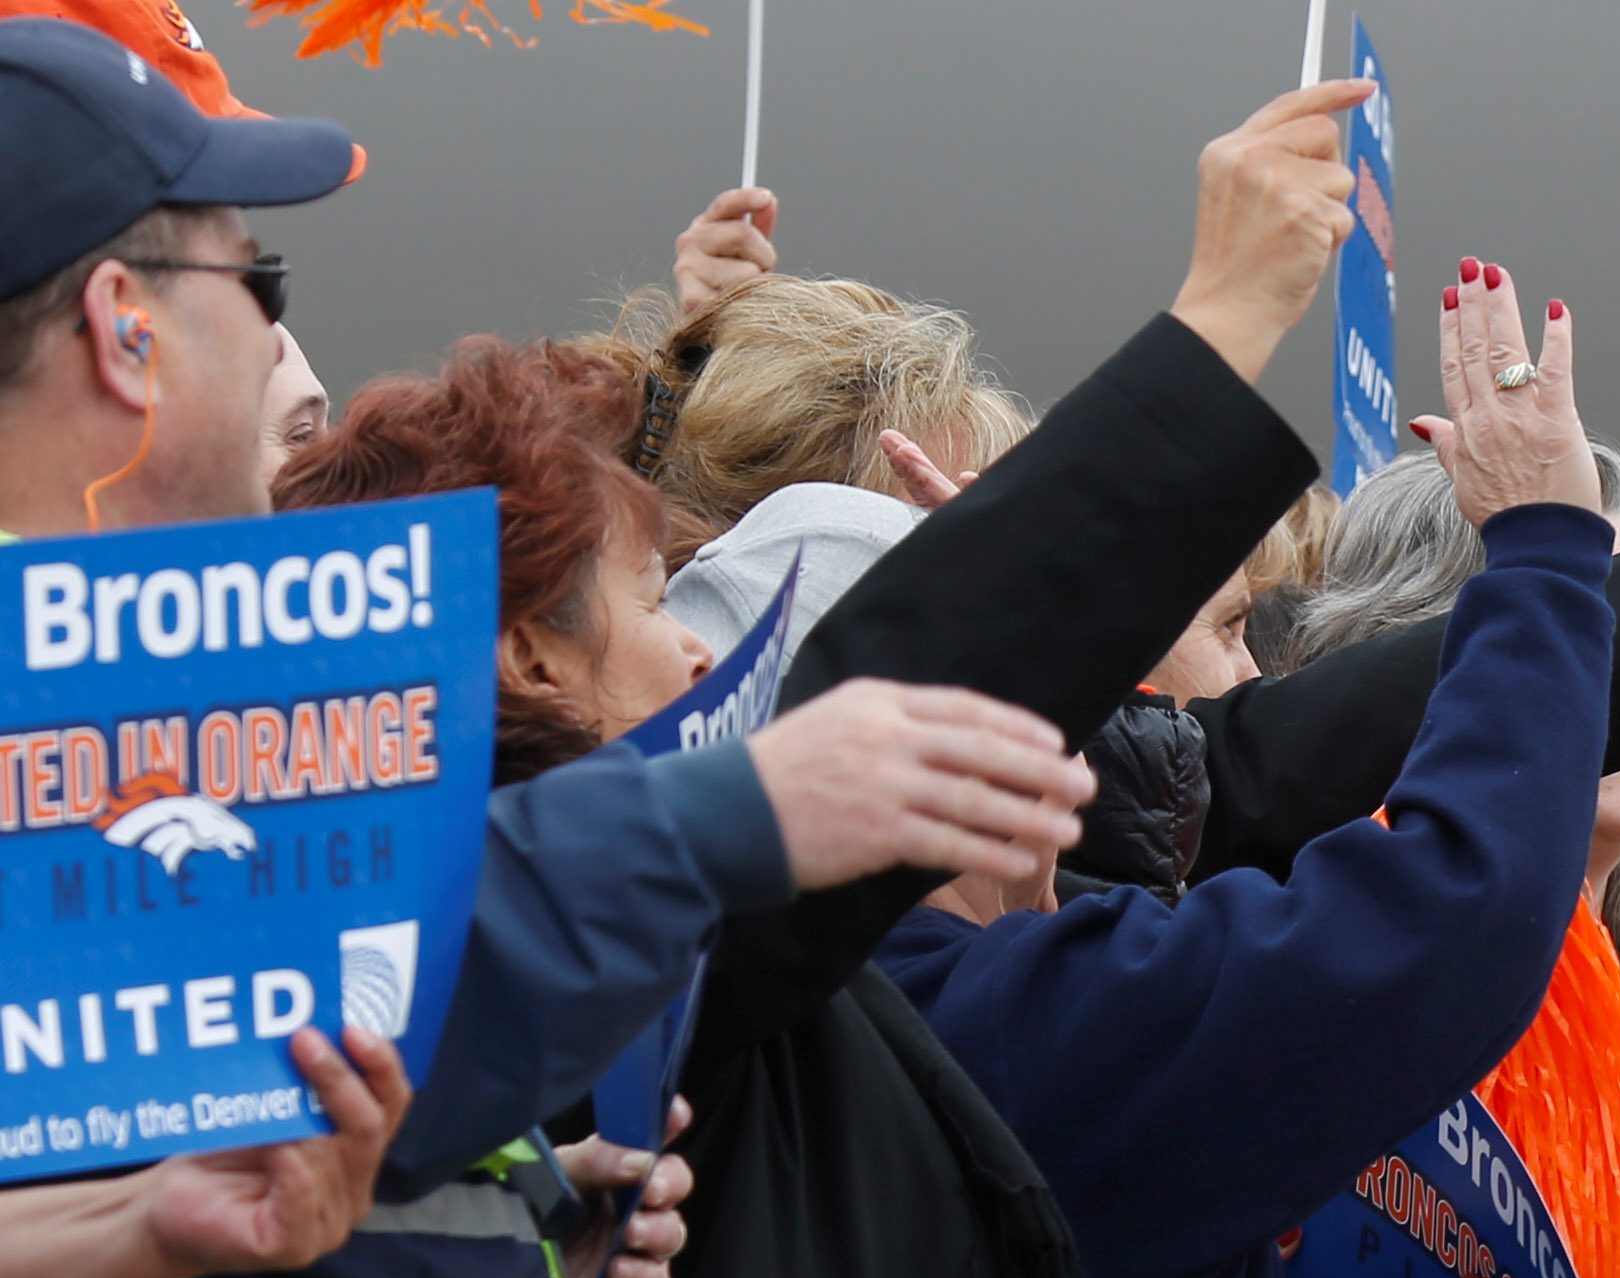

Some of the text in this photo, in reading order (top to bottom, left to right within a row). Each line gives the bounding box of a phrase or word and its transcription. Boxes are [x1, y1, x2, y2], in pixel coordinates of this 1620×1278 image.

[24, 523, 432, 671] Broncos!
[117, 716, 189, 795] IN
[198, 686, 439, 806] ORANGE
[53, 824, 393, 921] MILE HIGH
[2, 969, 315, 1074] NITED
[47, 1114, 84, 1151] to
[86, 1104, 132, 1149] fly
[135, 1099, 189, 1139] the
[191, 1085, 303, 1131] Denver
